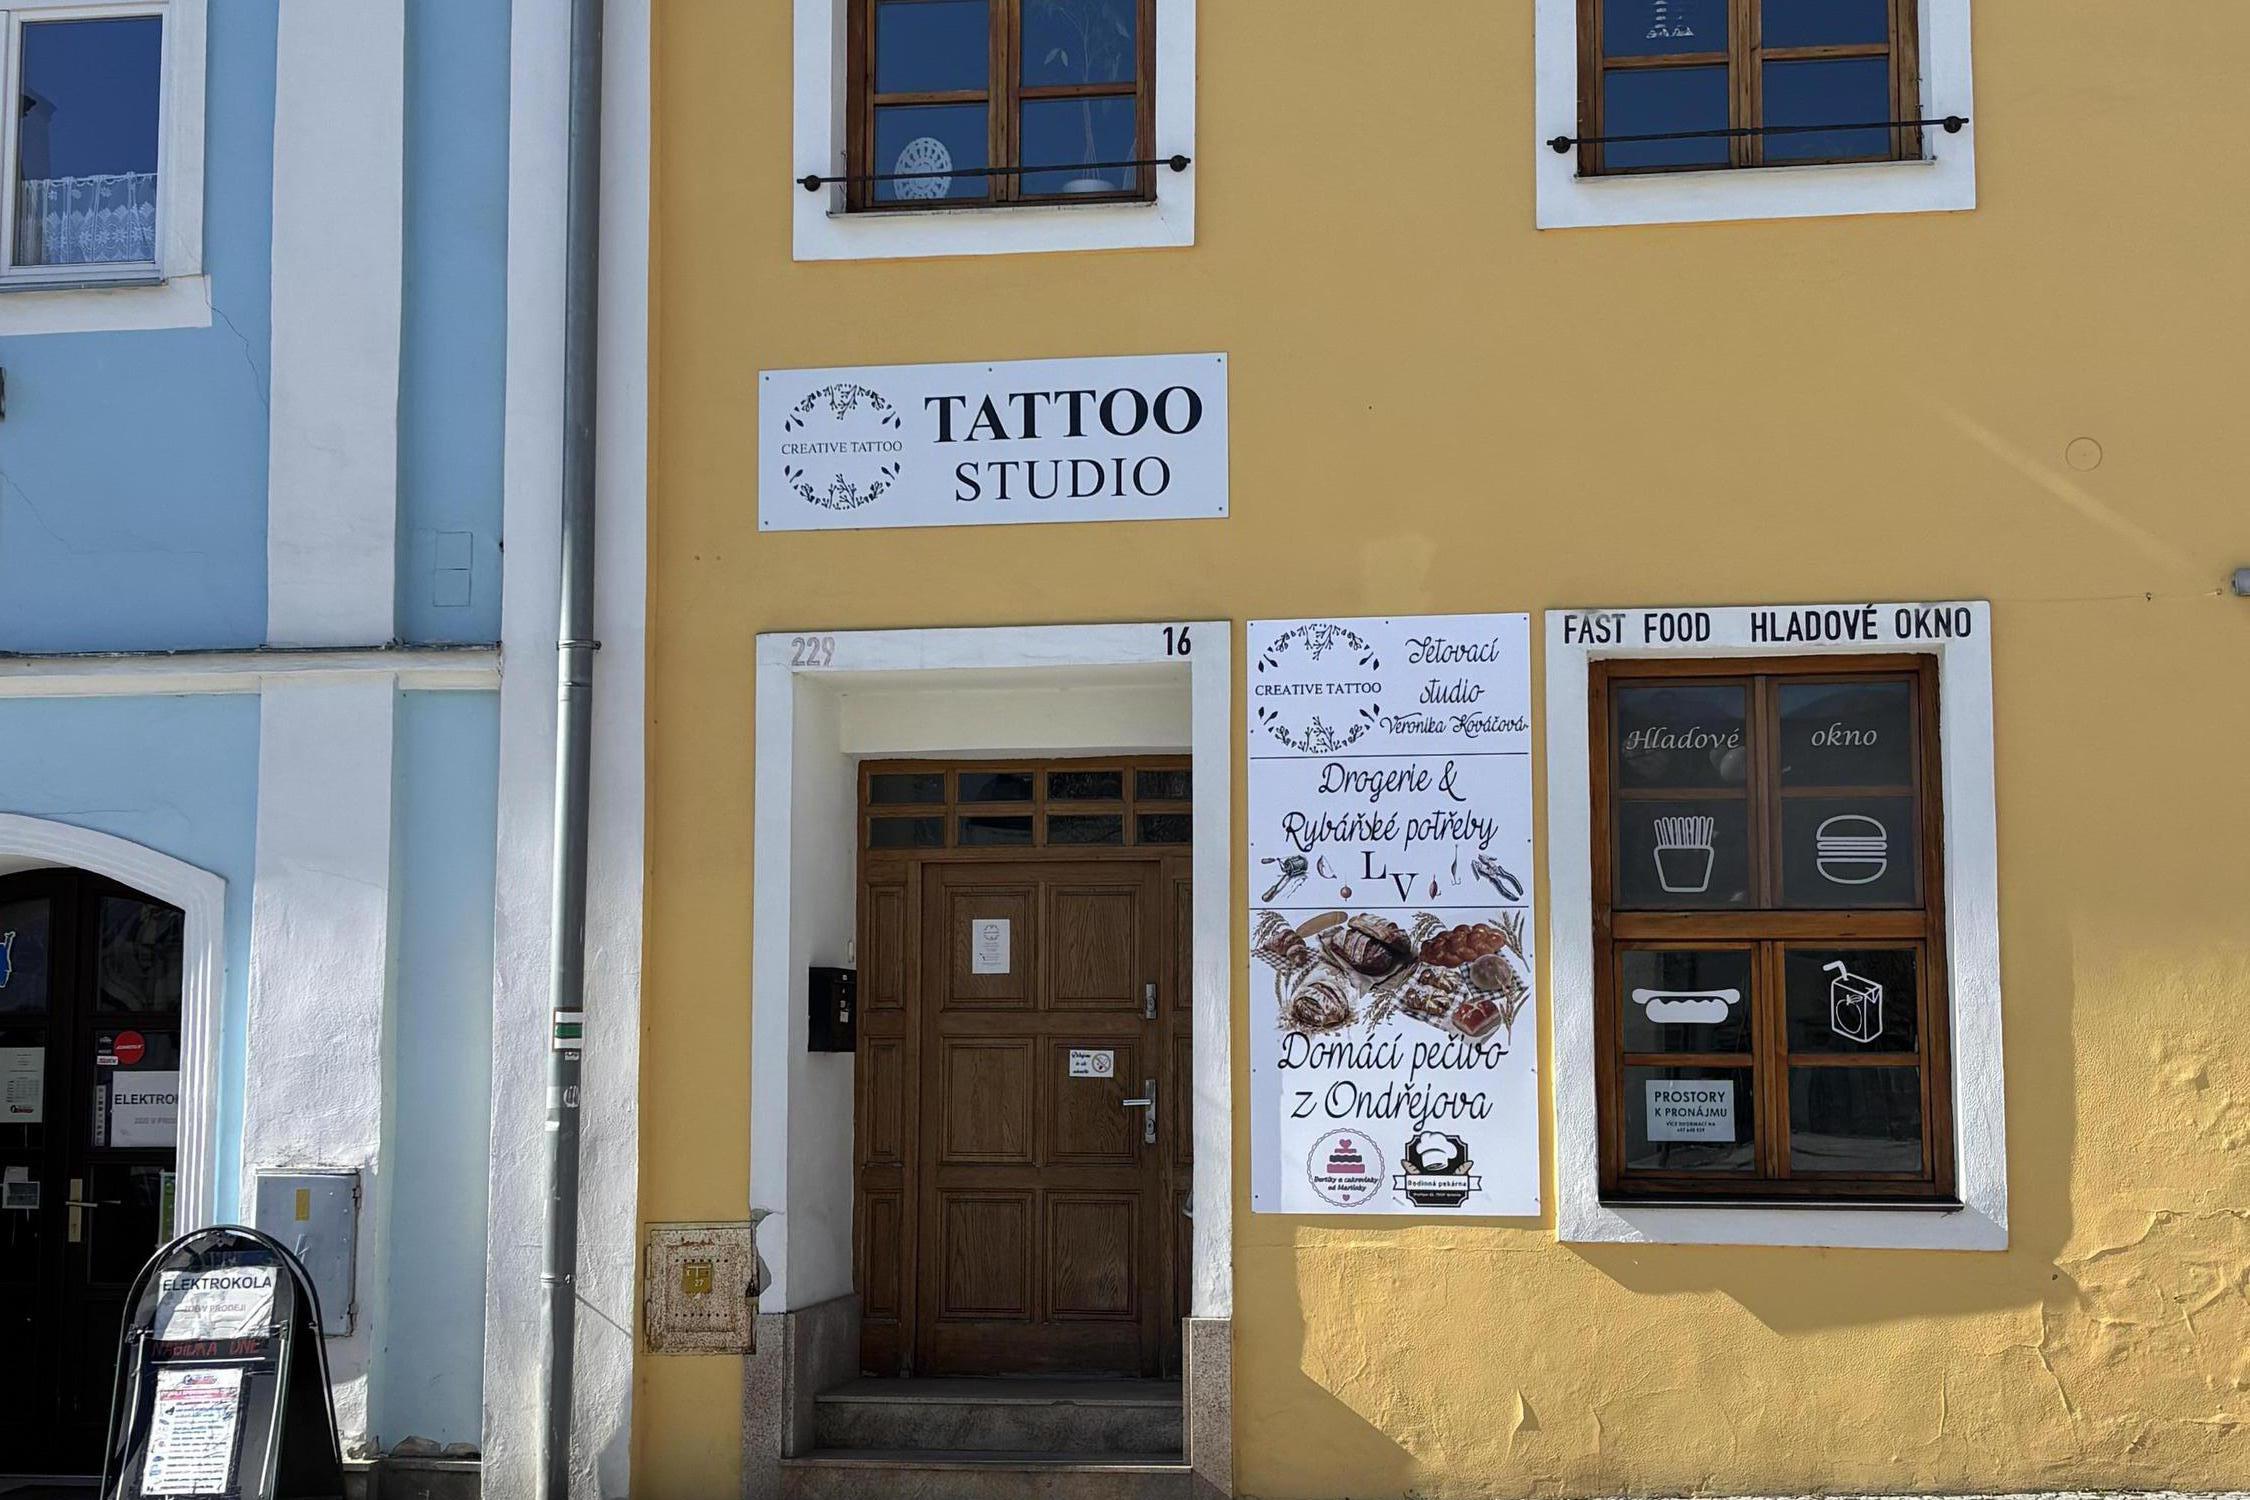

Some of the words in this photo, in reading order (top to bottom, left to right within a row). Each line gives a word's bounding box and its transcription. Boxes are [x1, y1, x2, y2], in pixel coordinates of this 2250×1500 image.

[925, 386, 1202, 443] TATTOO
[782, 442, 847, 454] CREATIVE
[851, 440, 902, 452] TATTOO
[956, 457, 1170, 501] STUDIO
[1565, 612, 1625, 644] FAST
[1645, 613, 1710, 643] FOOD
[1751, 603, 1878, 642] HLADOVÉ
[1895, 607, 1971, 638] OKNO
[791, 637, 835, 667] 229
[1163, 627, 1191, 655] 16
[1405, 636, 1499, 663] Tetovací
[1255, 684, 1322, 696] CREATIVE
[1326, 682, 1381, 694] TATTOO
[1420, 678, 1484, 704] studio
[1379, 712, 1447, 735] Veronika
[1448, 711, 1529, 738] Kováčová
[1625, 725, 1740, 752] Hladové
[1812, 723, 1877, 746] okno
[1319, 763, 1432, 803] Drogerie
[1439, 760, 1466, 801] &
[1282, 810, 1401, 852] Rybářské
[1404, 809, 1499, 851] potřeby
[1362, 851, 1386, 879] L
[1389, 873, 1418, 902] V
[1277, 1031, 1404, 1069] Domácí
[1409, 1033, 1509, 1082] pečivo
[1291, 1092, 1317, 1118] z
[1325, 1079, 1493, 1131] Ondřejova
[1655, 1091, 1725, 1102] PROSTORY
[1655, 1108, 1661, 1117] K
[1665, 1106, 1727, 1117] PRONÁJMU
[163, 1276, 272, 1292] ELEKTROKOLA
